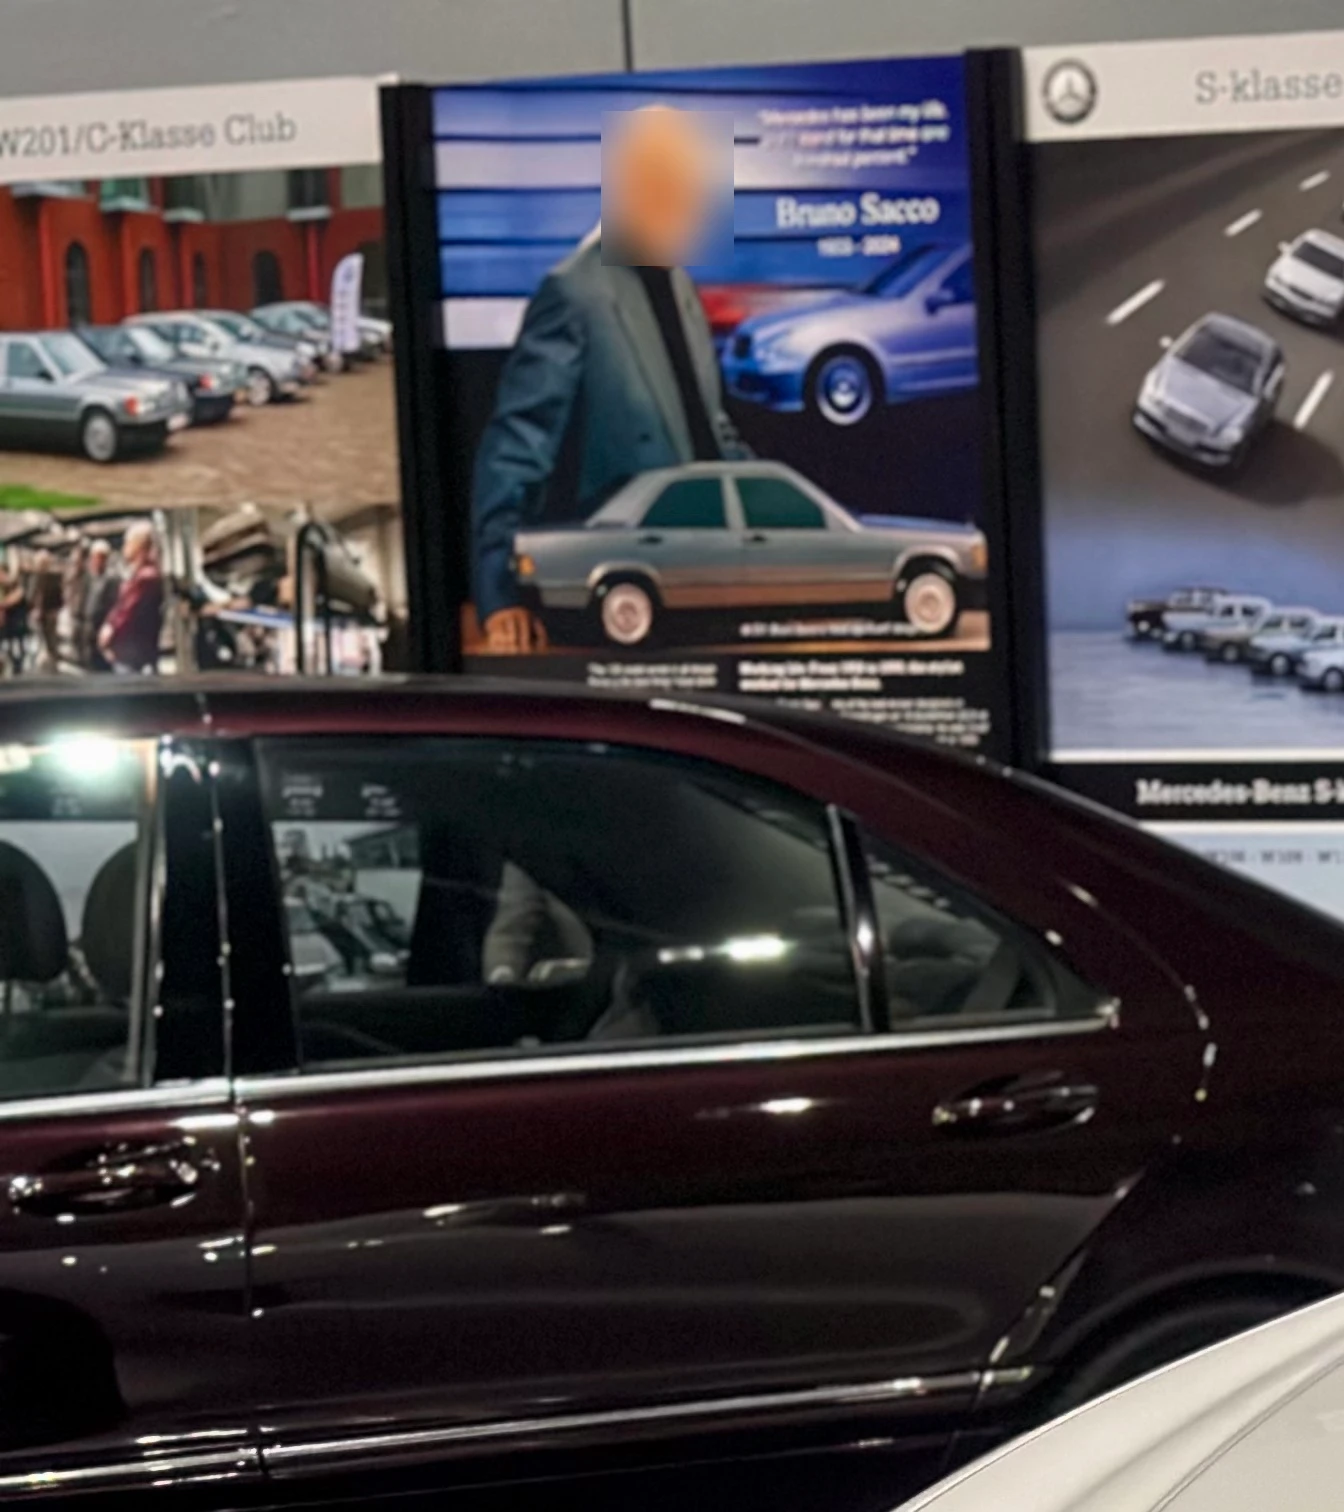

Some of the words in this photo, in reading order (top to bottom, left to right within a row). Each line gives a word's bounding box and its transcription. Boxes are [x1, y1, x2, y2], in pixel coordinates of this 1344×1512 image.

[1194, 66, 1342, 105] S-klasse
[223, 110, 297, 147] Club
[775, 195, 857, 229] Bruno
[859, 191, 941, 226] Sacco
[1136, 779, 1311, 805] Mercedes-Benz
